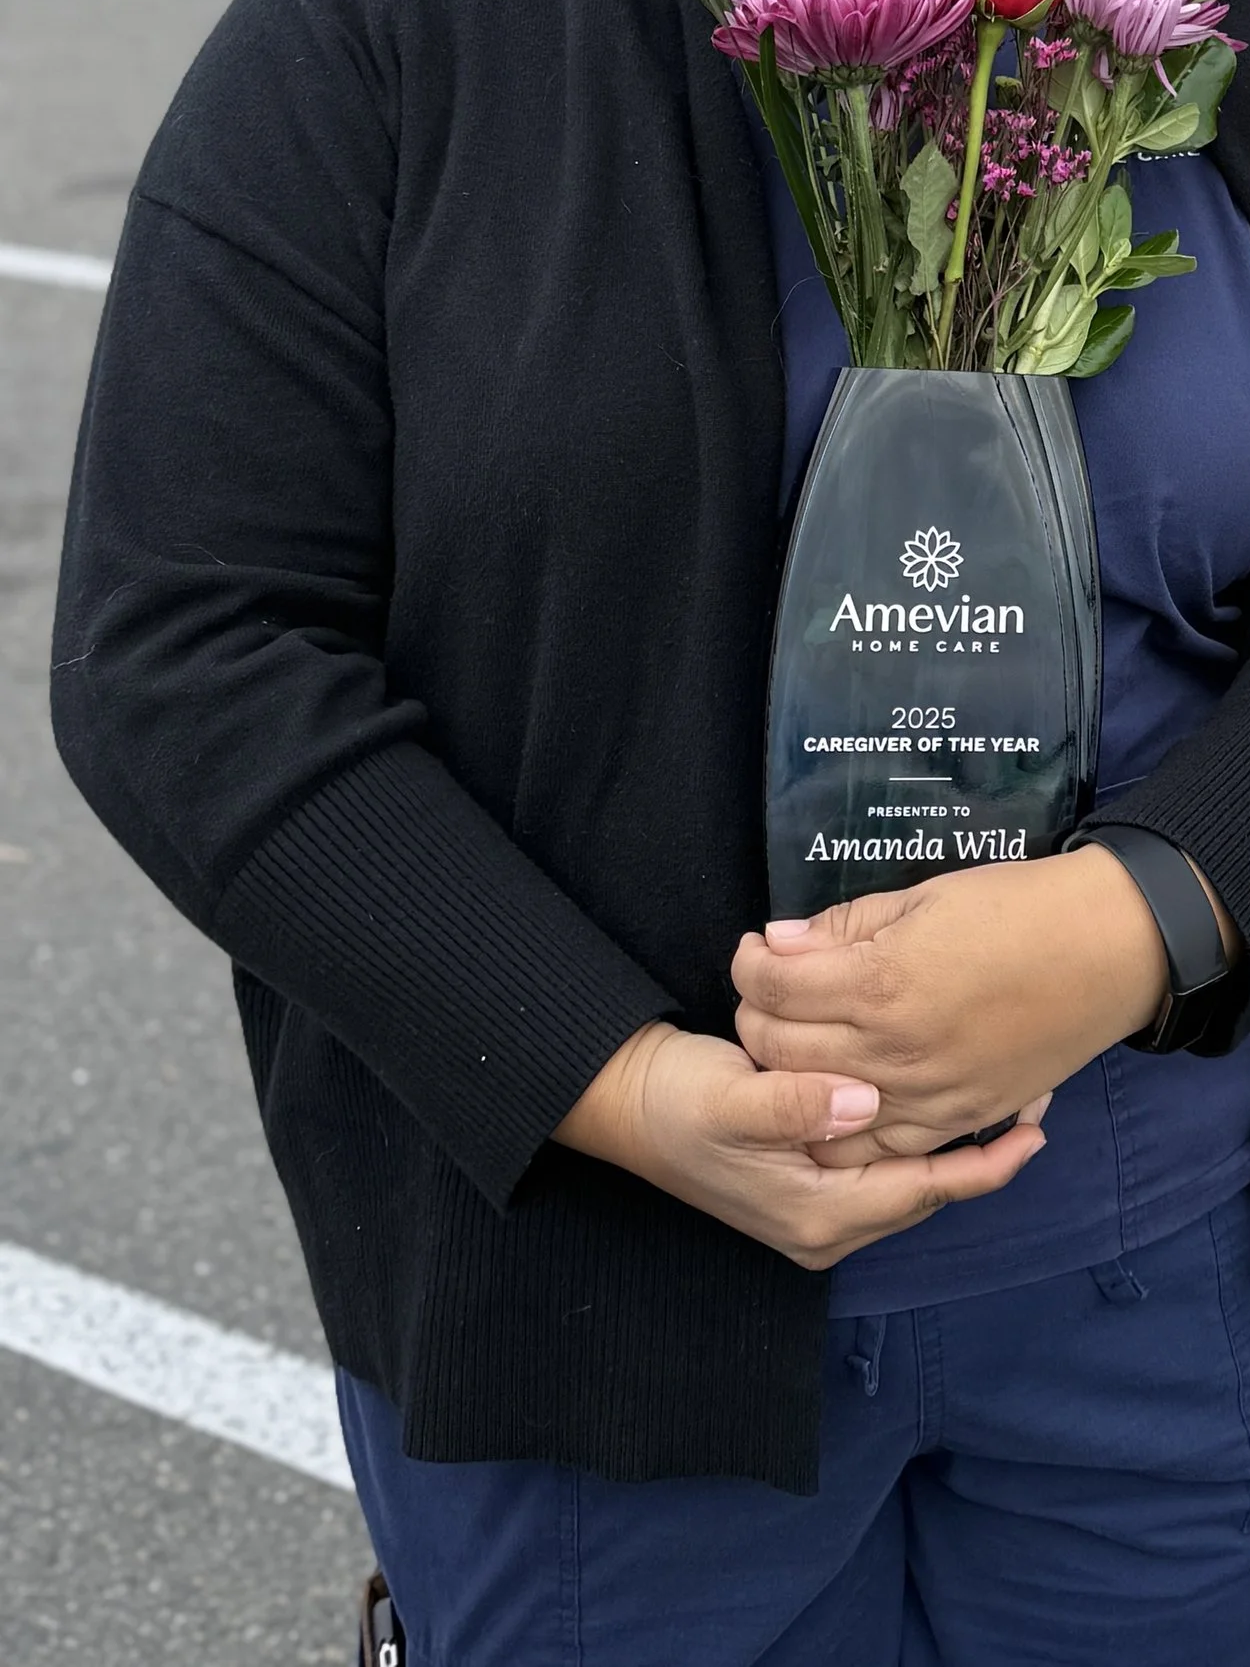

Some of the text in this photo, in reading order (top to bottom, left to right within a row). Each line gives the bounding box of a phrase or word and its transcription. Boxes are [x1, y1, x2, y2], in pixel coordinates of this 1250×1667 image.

[829, 592, 1024, 634] Amevian
[852, 639, 1000, 653] HOME CARE
[891, 707, 956, 729] 2025
[803, 736, 1040, 752] CAREGIVER OF THE YEAR
[867, 806, 971, 817] PRESENTED TO
[804, 828, 1028, 861] Amanda Wild
